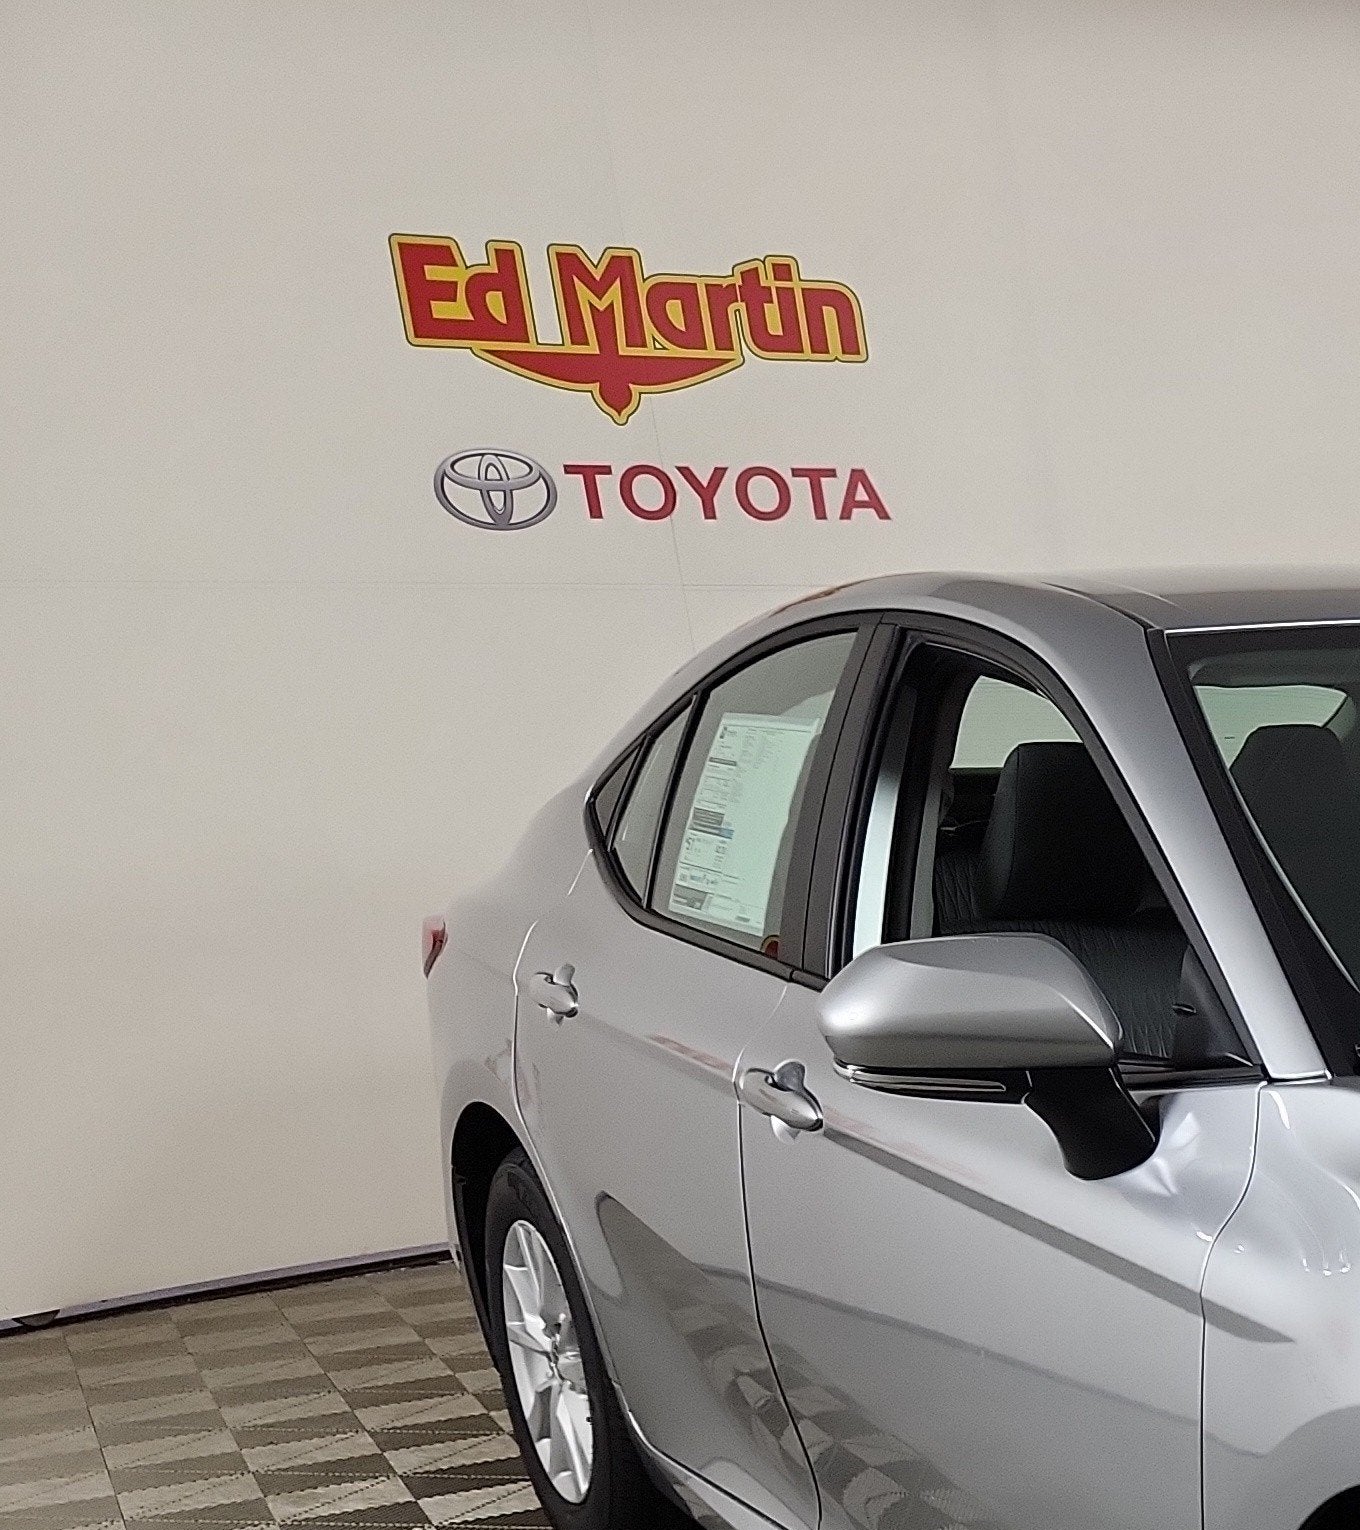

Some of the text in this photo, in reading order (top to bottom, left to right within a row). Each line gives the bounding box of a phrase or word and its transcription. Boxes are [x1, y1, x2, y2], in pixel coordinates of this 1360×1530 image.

[390, 234, 869, 362] Ed Martin
[563, 464, 892, 522] TOYOTA
